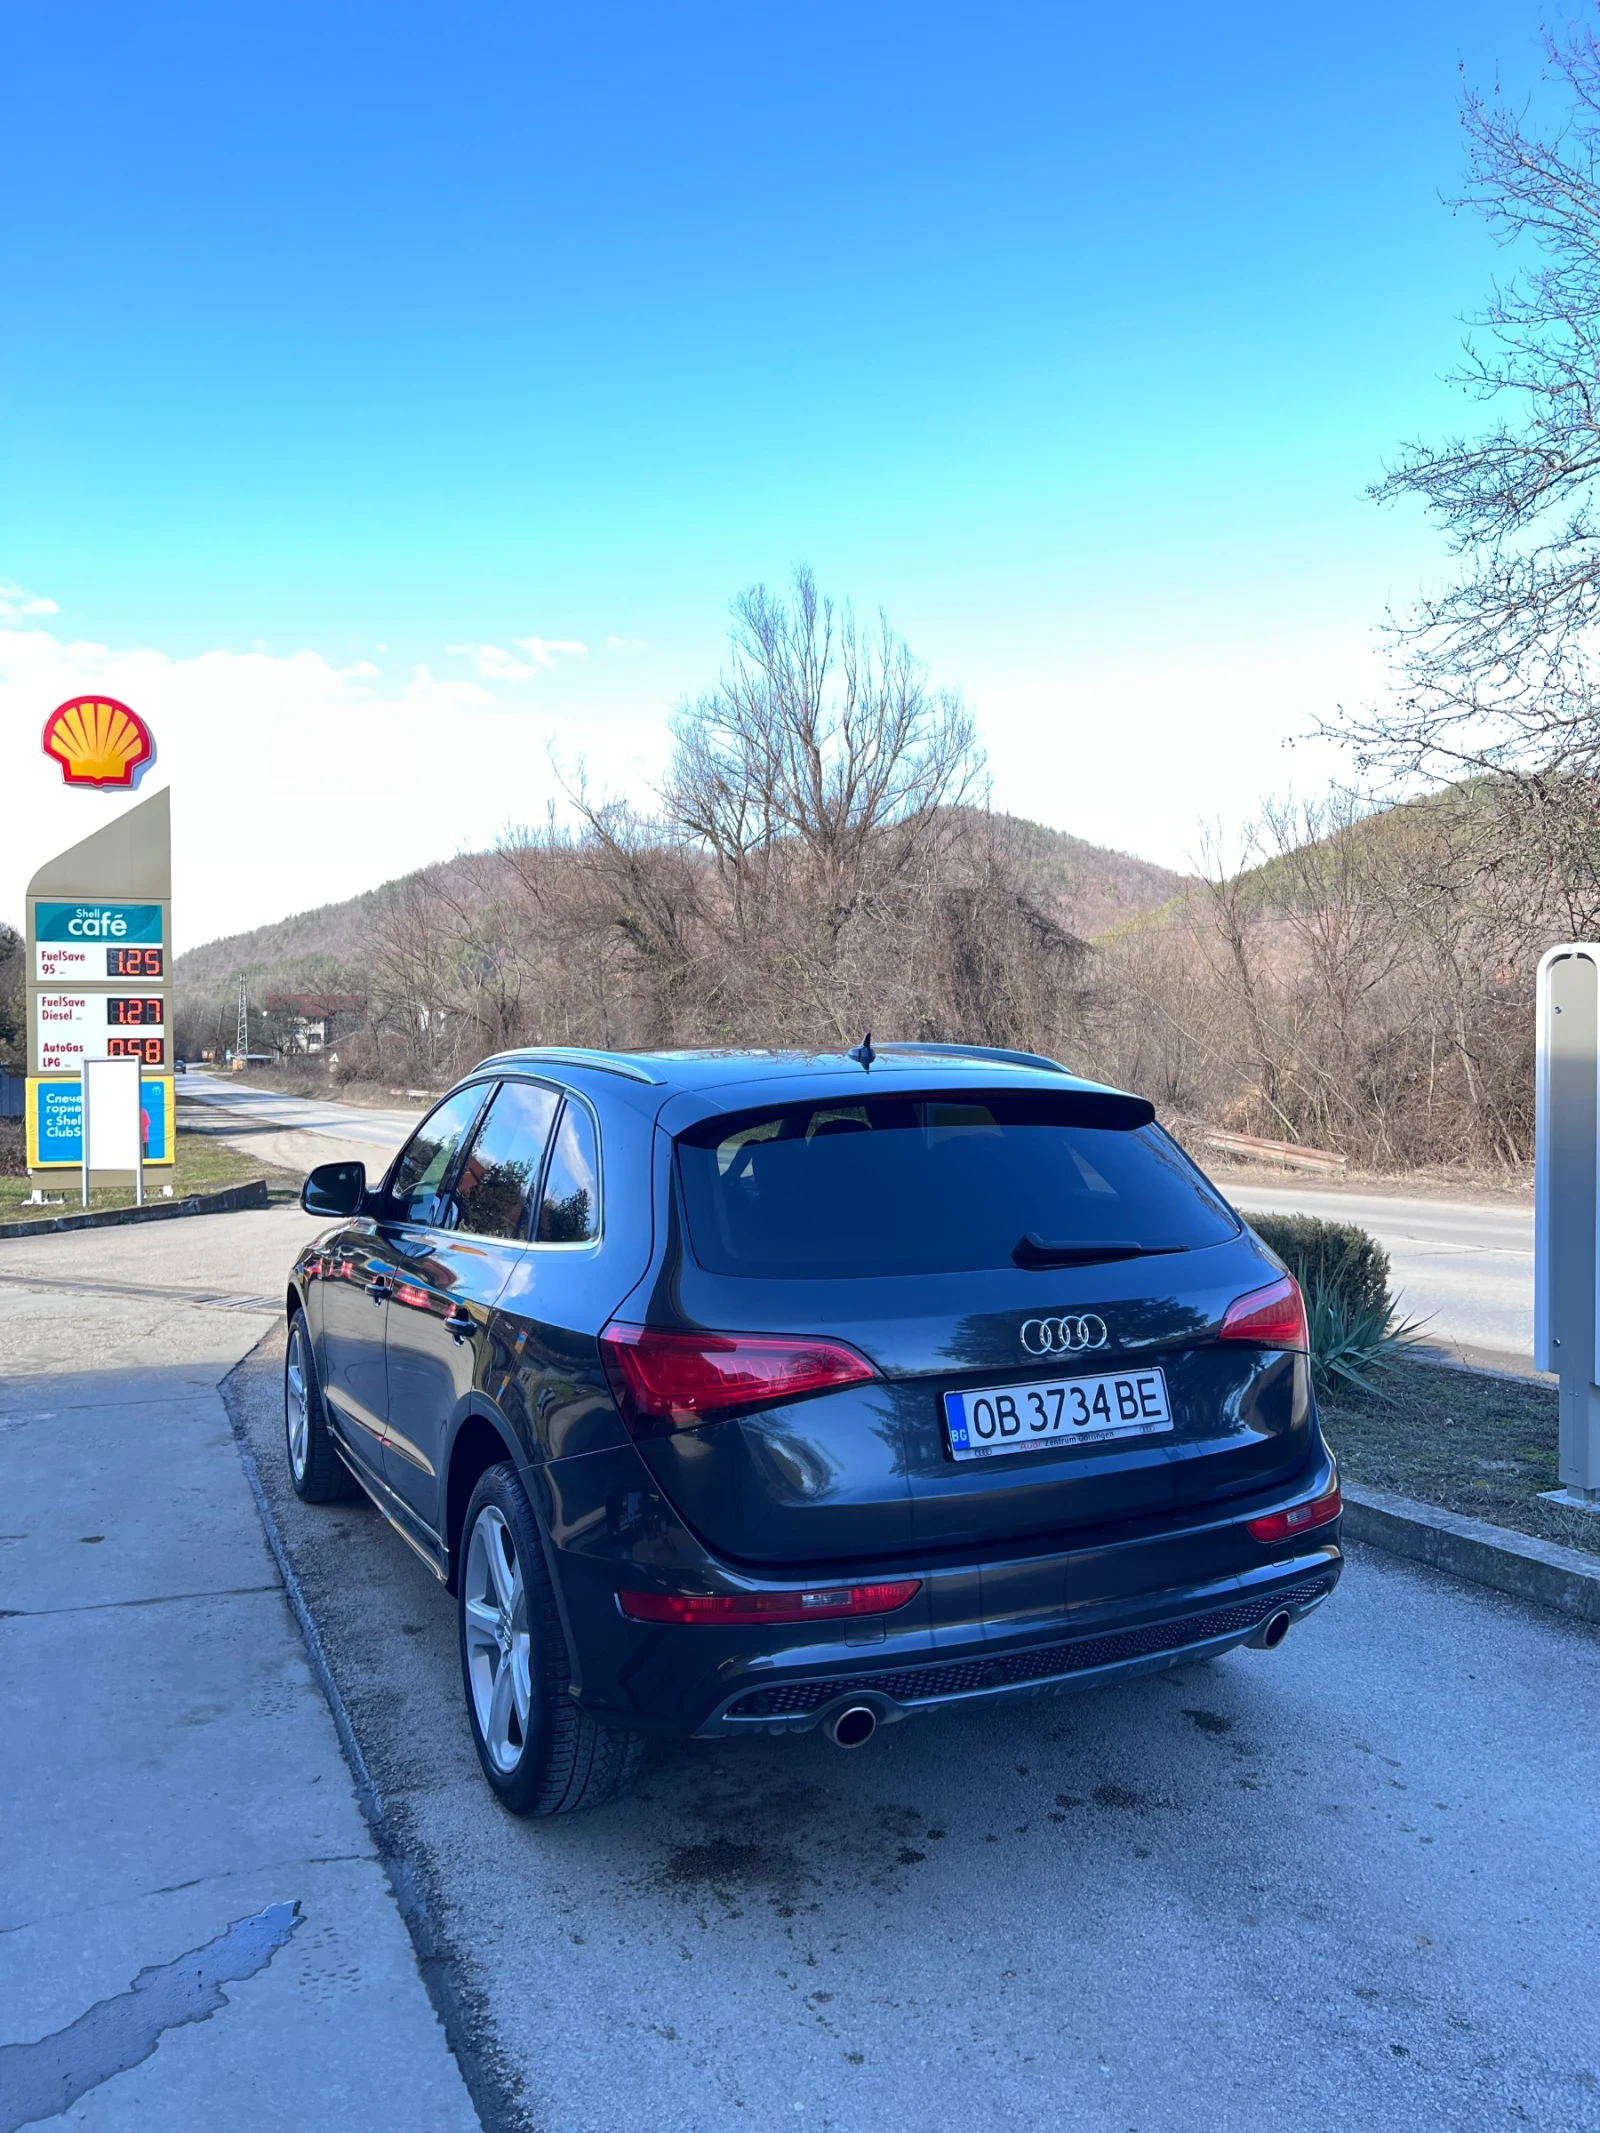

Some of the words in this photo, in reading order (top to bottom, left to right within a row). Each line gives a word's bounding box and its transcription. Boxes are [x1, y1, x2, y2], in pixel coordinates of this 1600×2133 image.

[76, 908, 100, 918] Shell
[68, 911, 127, 936] café
[41, 950, 86, 962] FuelSave
[42, 964, 55, 975] 95
[41, 996, 86, 1008] FuelSave
[42, 1009, 72, 1021] Diesel
[43, 1042, 84, 1053] AutoGas
[43, 1057, 60, 1068] LPG
[46, 1126, 82, 1137] ClubS
[951, 1429, 967, 1443] BG
[1020, 1440, 1042, 1451] Audi
[1044, 1436, 1076, 1447] Zentrum
